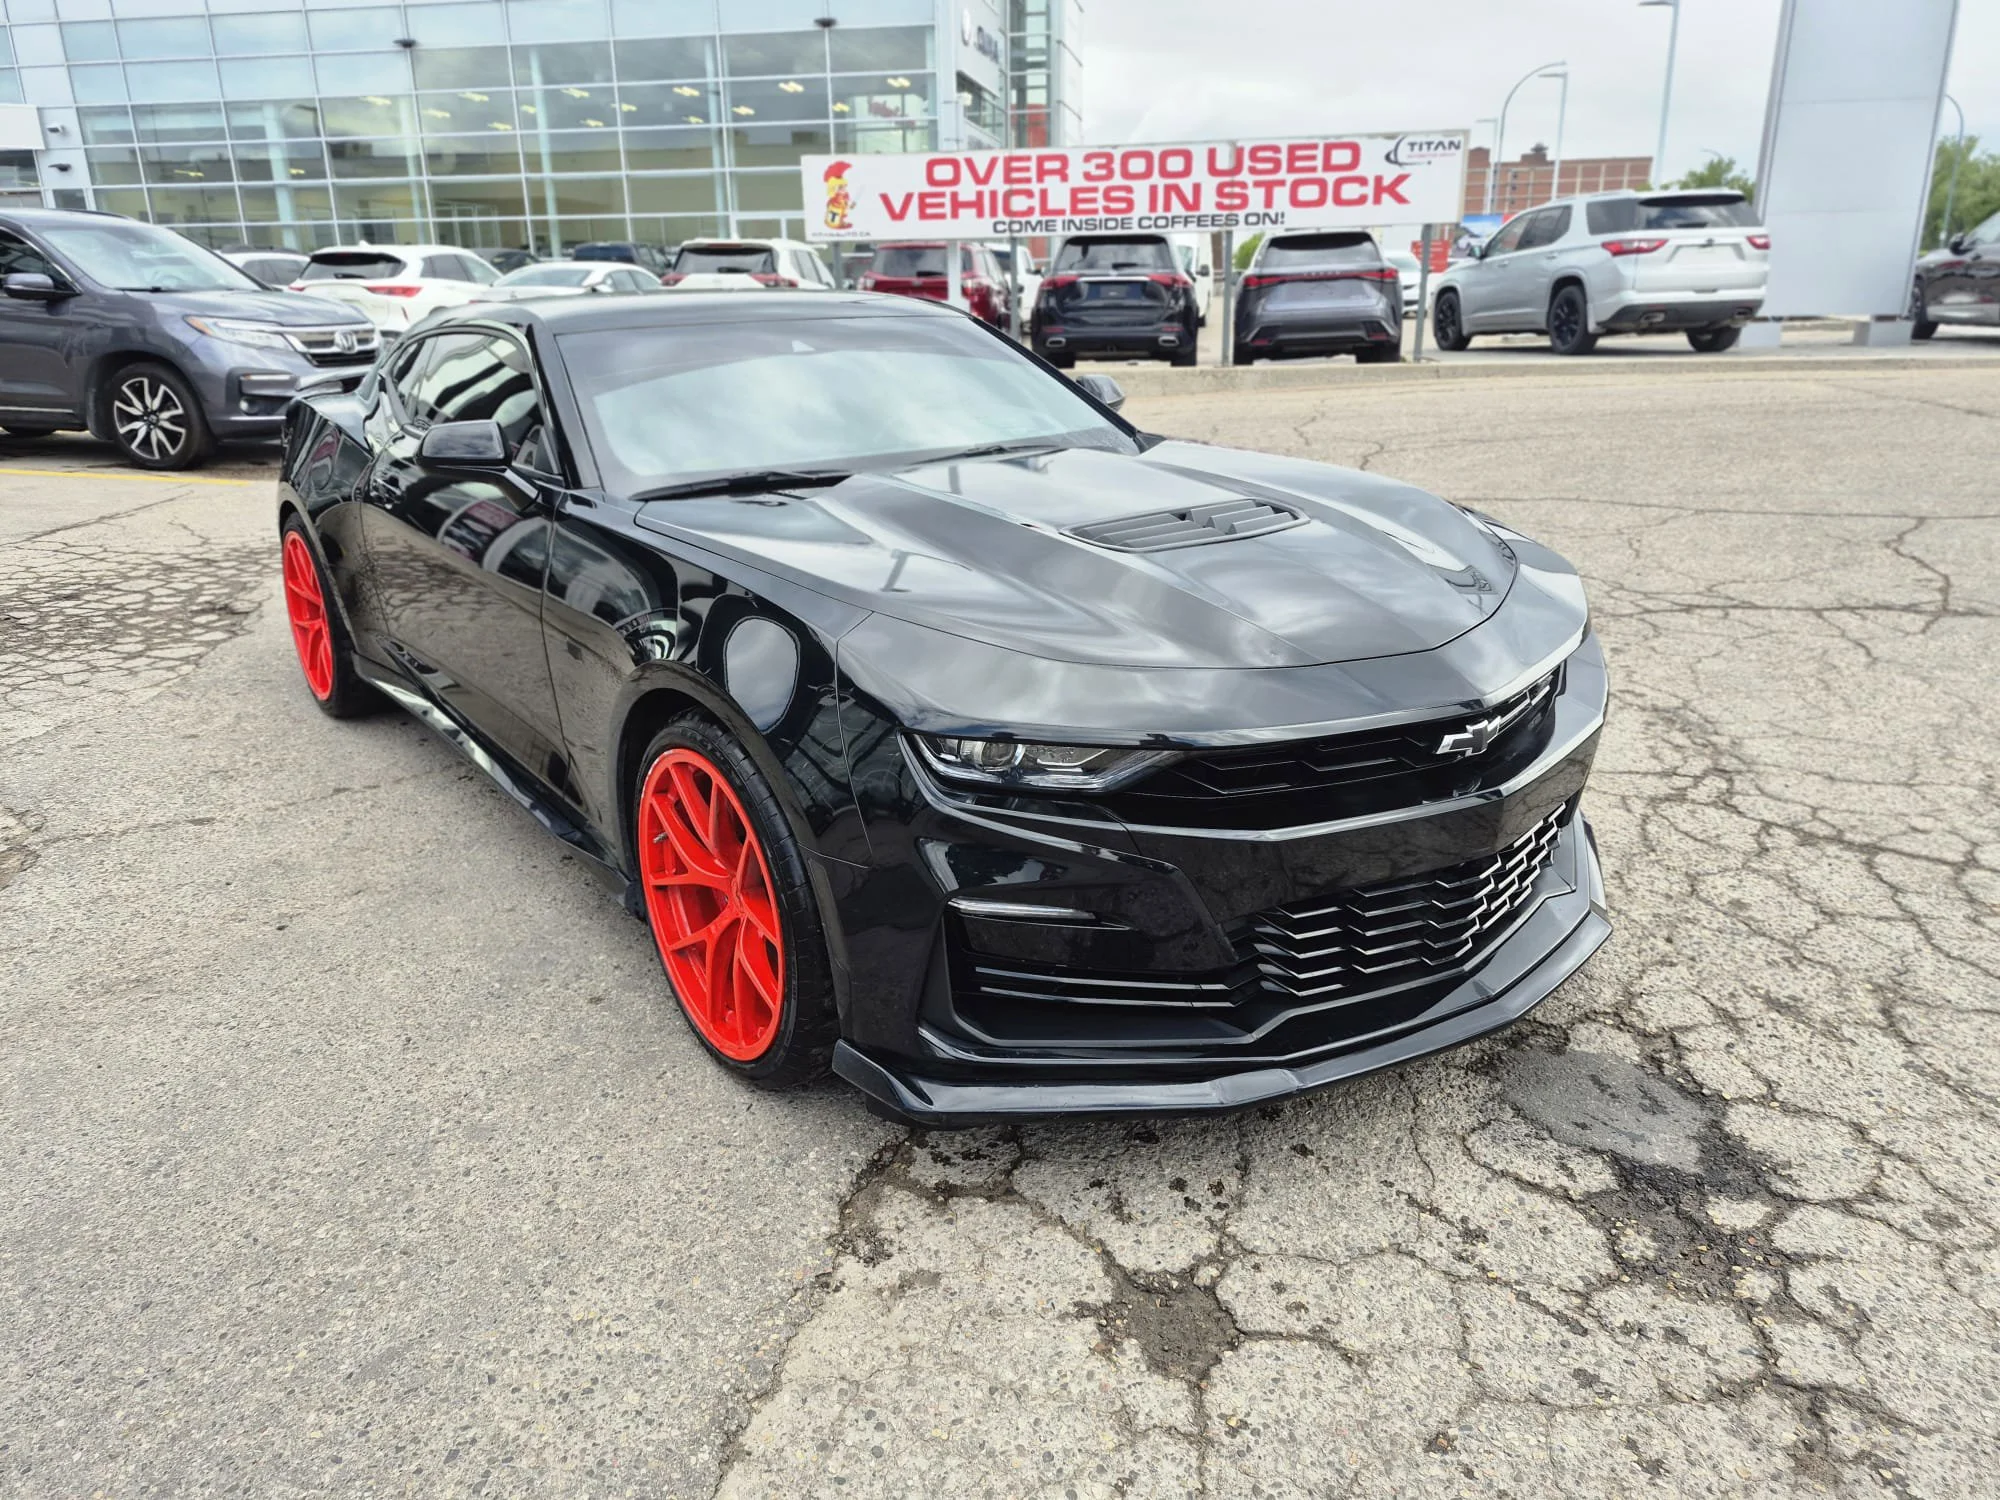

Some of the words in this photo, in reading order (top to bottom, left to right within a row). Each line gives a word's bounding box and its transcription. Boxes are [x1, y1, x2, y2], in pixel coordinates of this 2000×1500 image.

[1407, 140, 1461, 152] TITAN
[925, 153, 1069, 188] OVER
[1082, 147, 1193, 183] 300
[1206, 141, 1361, 178] USED
[879, 184, 1135, 221] VEHICLES
[1148, 182, 1201, 214] IN
[1214, 173, 1411, 212] STOCK
[992, 219, 1057, 234] COME
[1062, 216, 1133, 232] INSIDE
[1137, 213, 1239, 230] COFFEES
[1244, 211, 1285, 226] ON!
